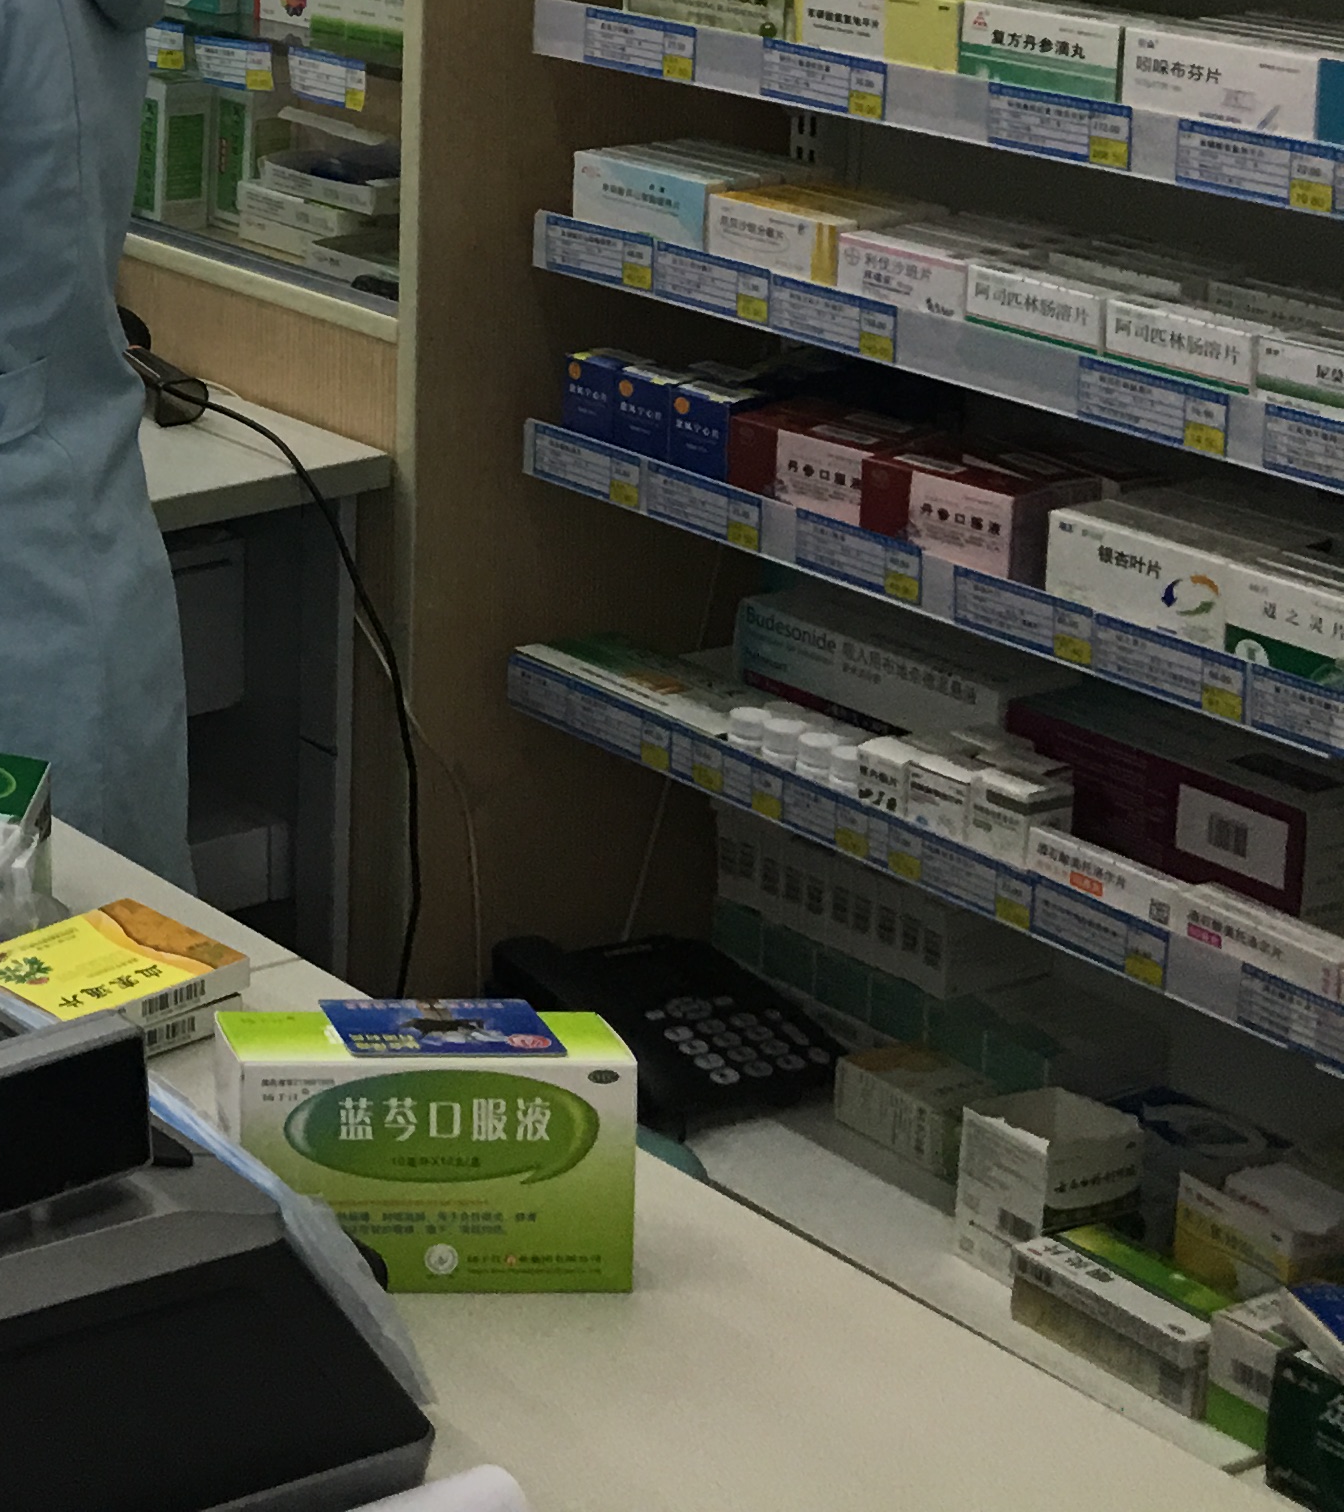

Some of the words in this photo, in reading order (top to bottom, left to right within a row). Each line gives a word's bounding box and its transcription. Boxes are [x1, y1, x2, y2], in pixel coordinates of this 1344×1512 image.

[990, 29, 1086, 60] 复方丹参滴丸
[1135, 55, 1222, 85] 吲哚布芬片
[974, 281, 1088, 327] 阿司匹林肠溶片
[1114, 317, 1241, 366] 阿司匹林肠溶片
[919, 502, 1002, 537] 丹参口服液
[1097, 545, 1162, 580] 银杏叶片
[745, 606, 837, 654] Budesonide
[339, 1096, 552, 1143] 蓝芩口服液
